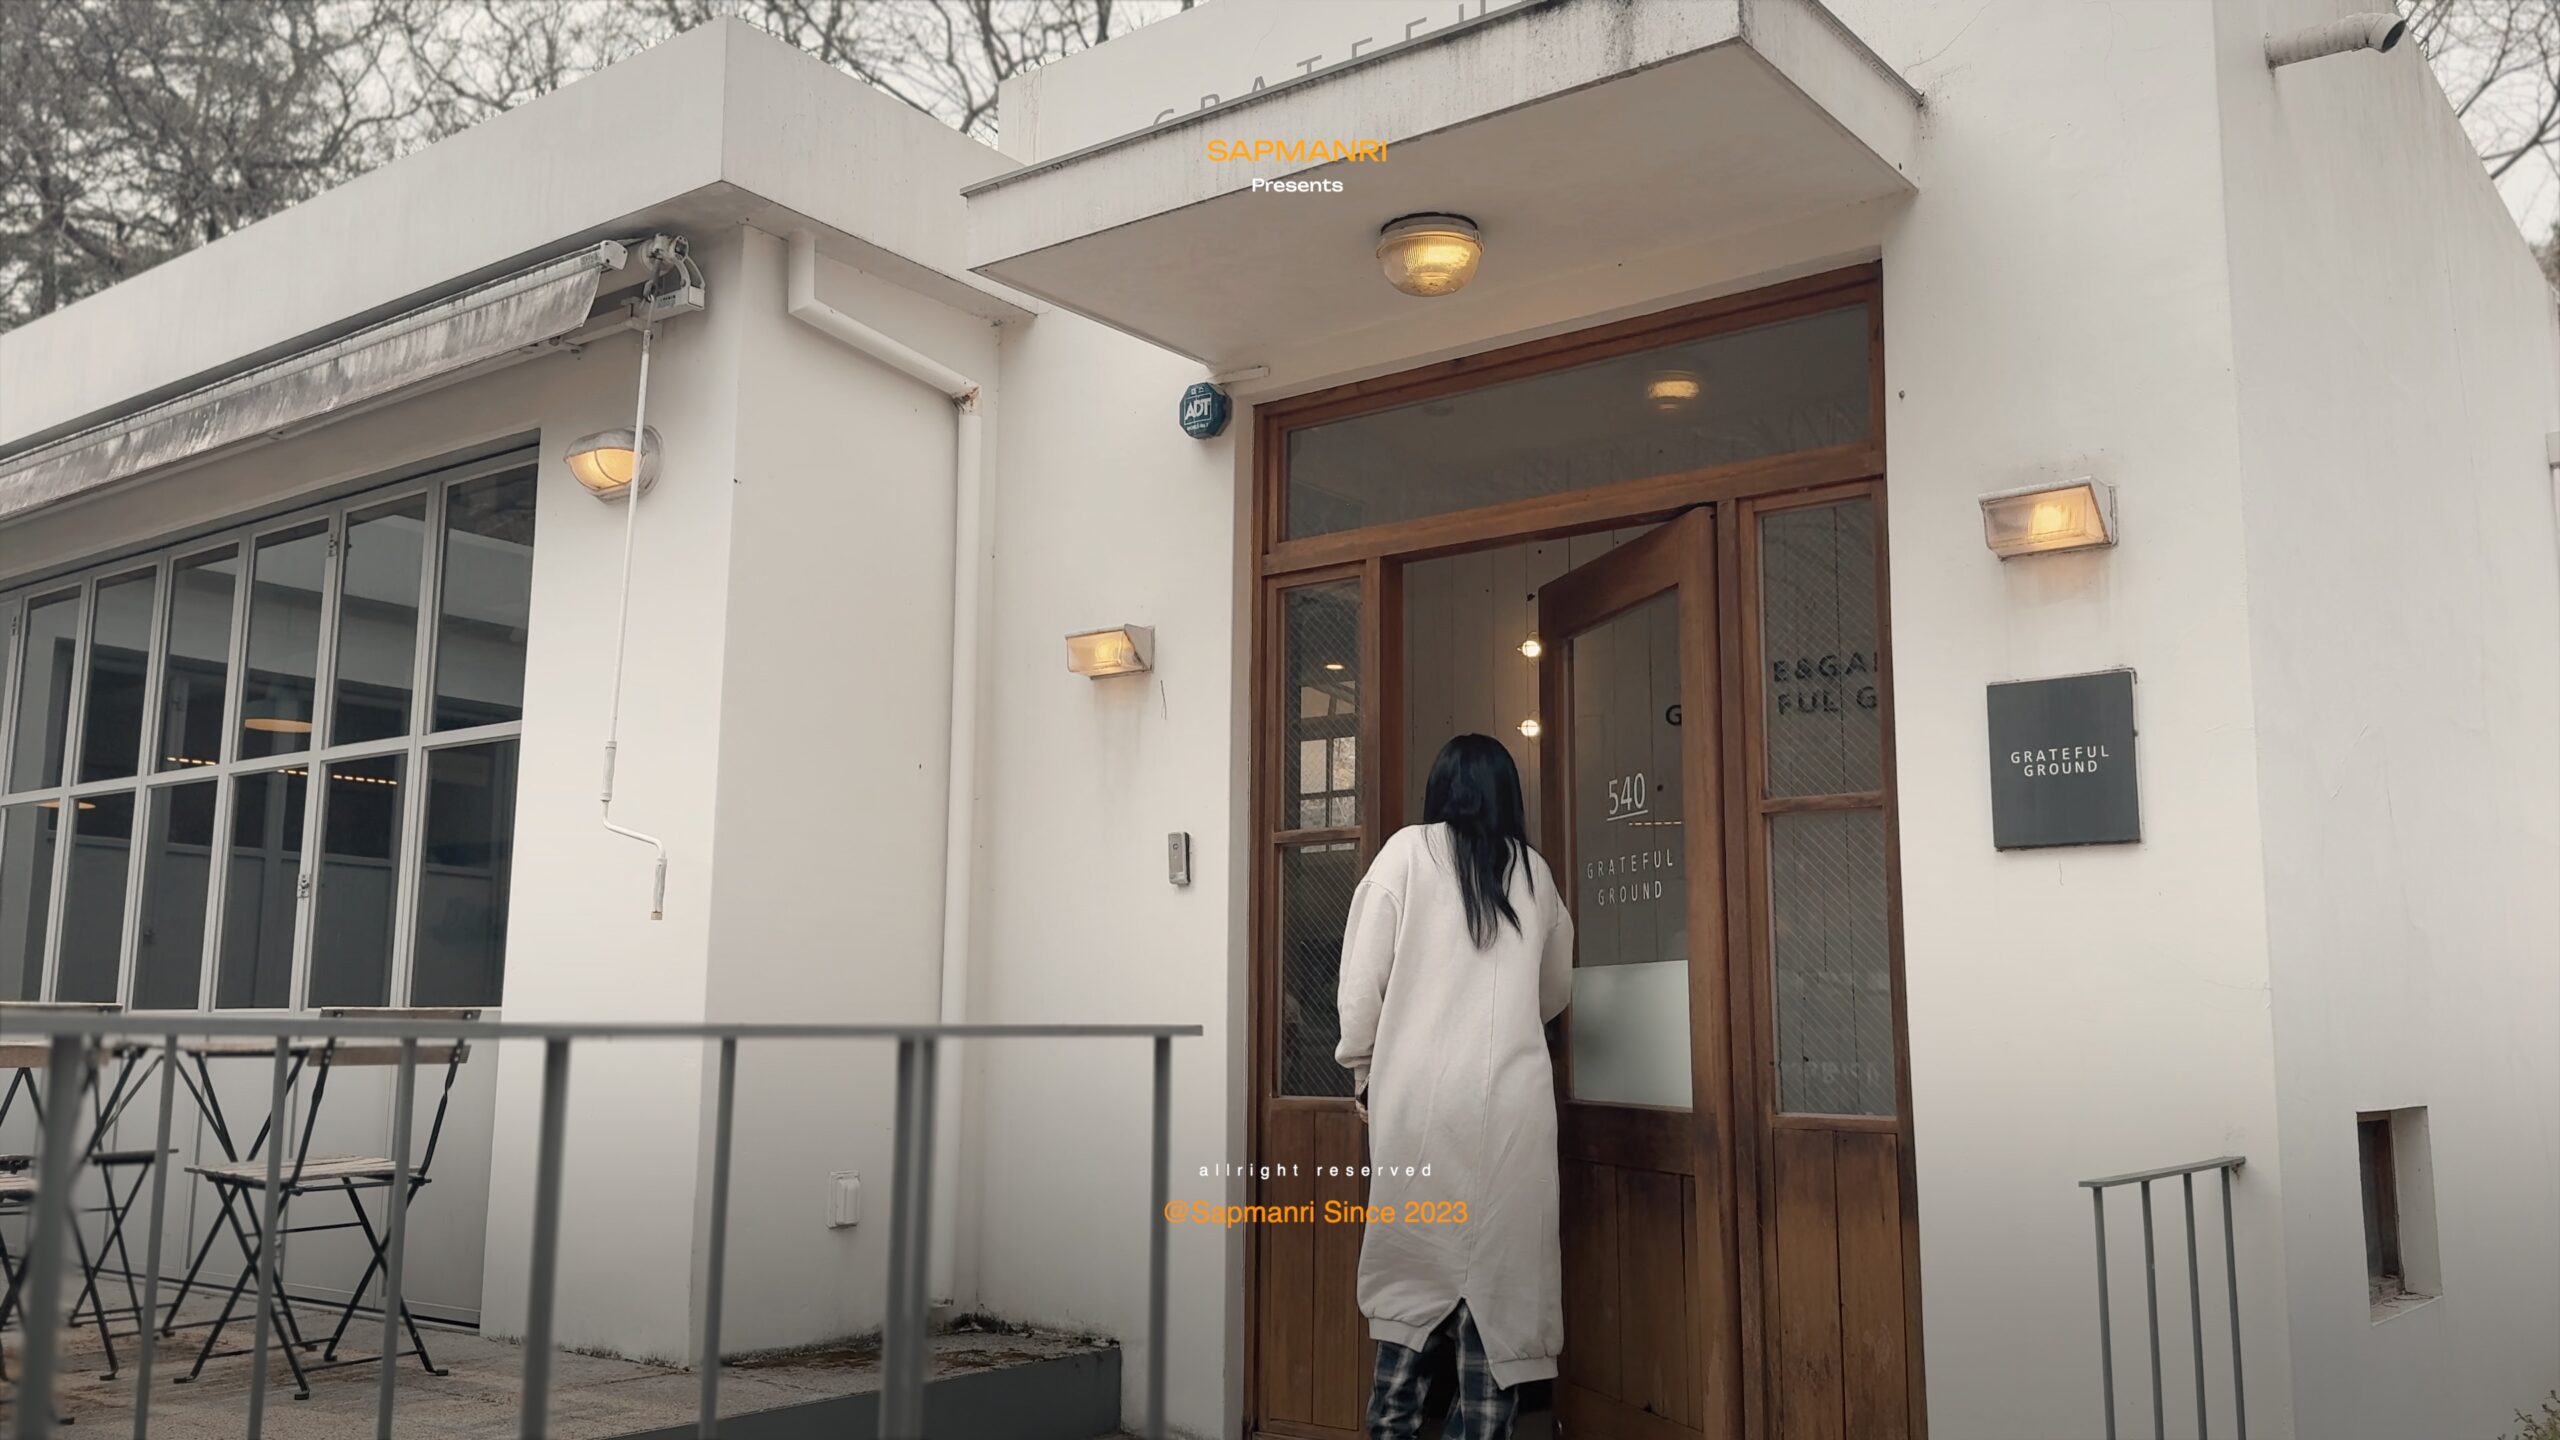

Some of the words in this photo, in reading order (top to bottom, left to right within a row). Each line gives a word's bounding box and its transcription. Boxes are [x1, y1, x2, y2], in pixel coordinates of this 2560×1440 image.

[1184, 397, 1212, 421] ADT
[2010, 745, 2109, 764] GRATEFUL
[2024, 760, 2098, 777] GROUND
[1608, 773, 1646, 815] 540
[1587, 848, 1673, 880] GRATEFUL
[1598, 880, 1662, 906] GROUND
